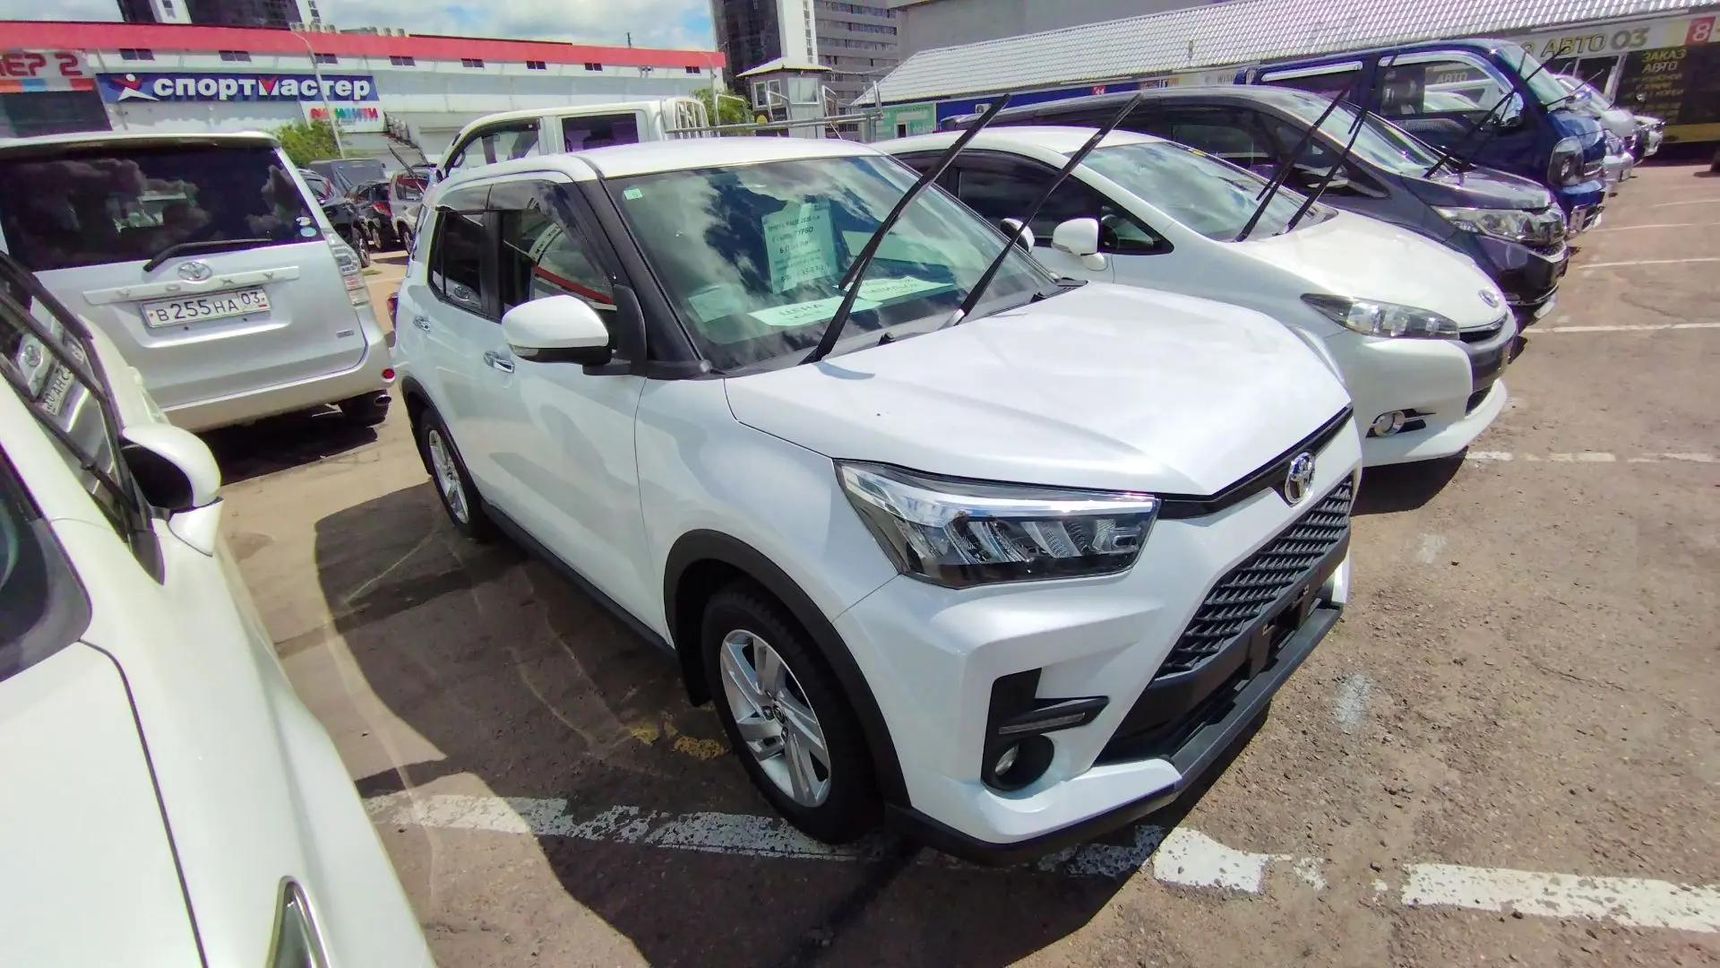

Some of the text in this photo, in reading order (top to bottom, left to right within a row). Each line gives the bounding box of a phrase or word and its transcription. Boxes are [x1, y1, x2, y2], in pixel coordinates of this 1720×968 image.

[1692, 22, 1711, 41] 8
[1540, 32, 1608, 57] АВТО
[54, 52, 83, 76] 2
[1641, 48, 1687, 62] ЗАКАЗ
[1641, 61, 1678, 74] АВТО
